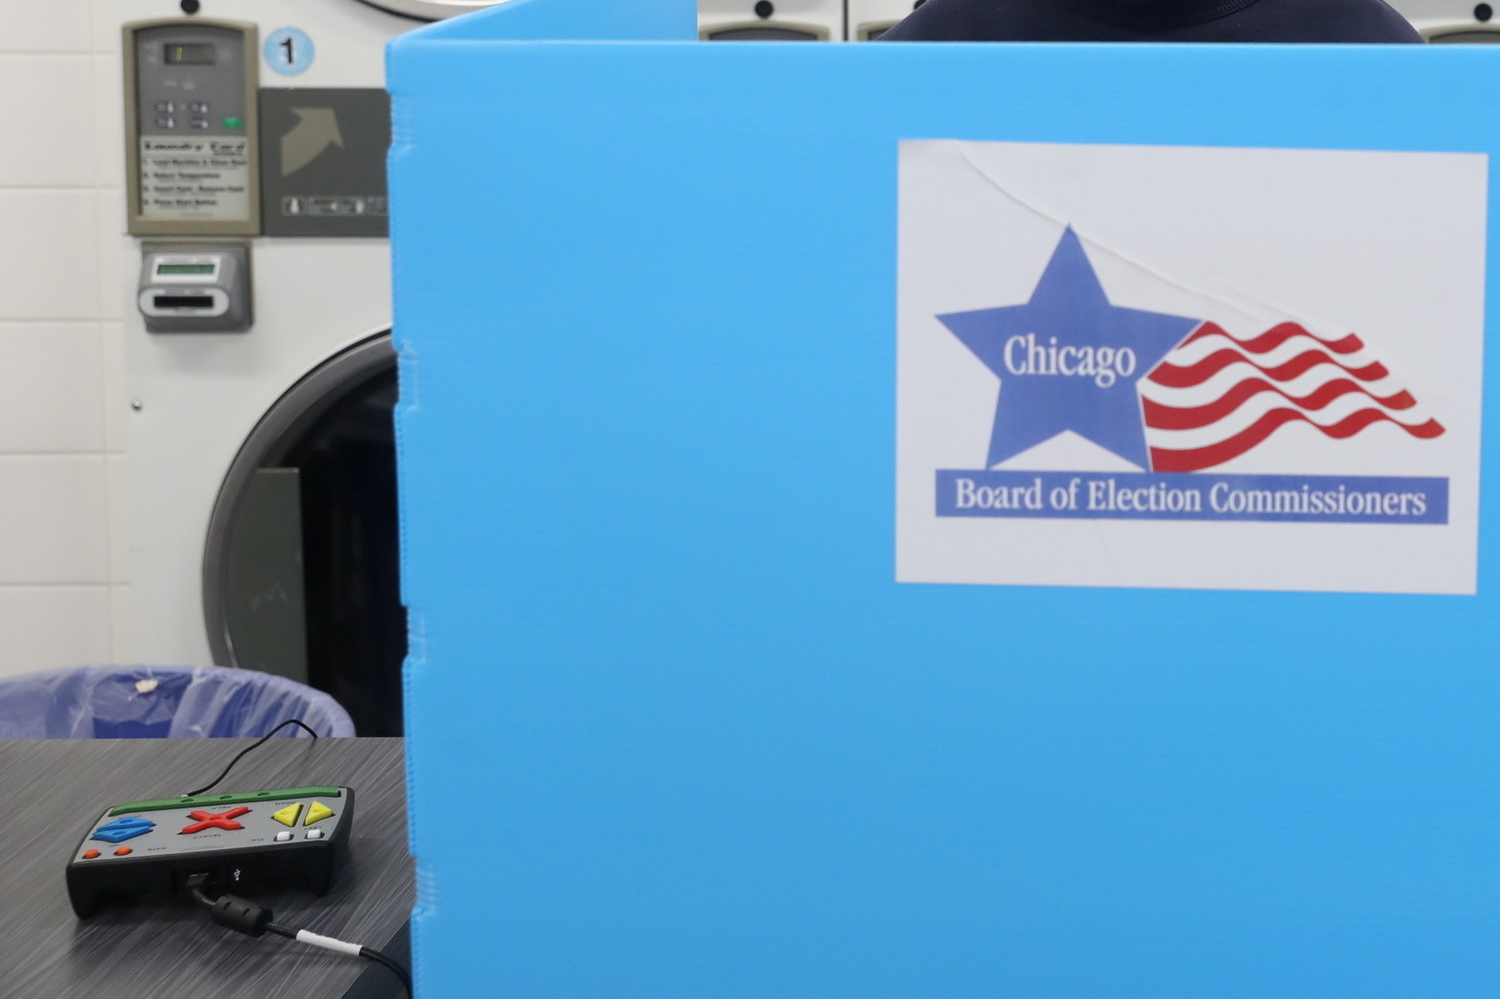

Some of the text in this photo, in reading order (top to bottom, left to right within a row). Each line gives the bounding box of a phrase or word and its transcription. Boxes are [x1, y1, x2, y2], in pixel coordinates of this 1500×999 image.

[280, 37, 293, 64] 1
[1004, 332, 1138, 388] Chicago
[955, 478, 1428, 516] Board of Election Commissioners
